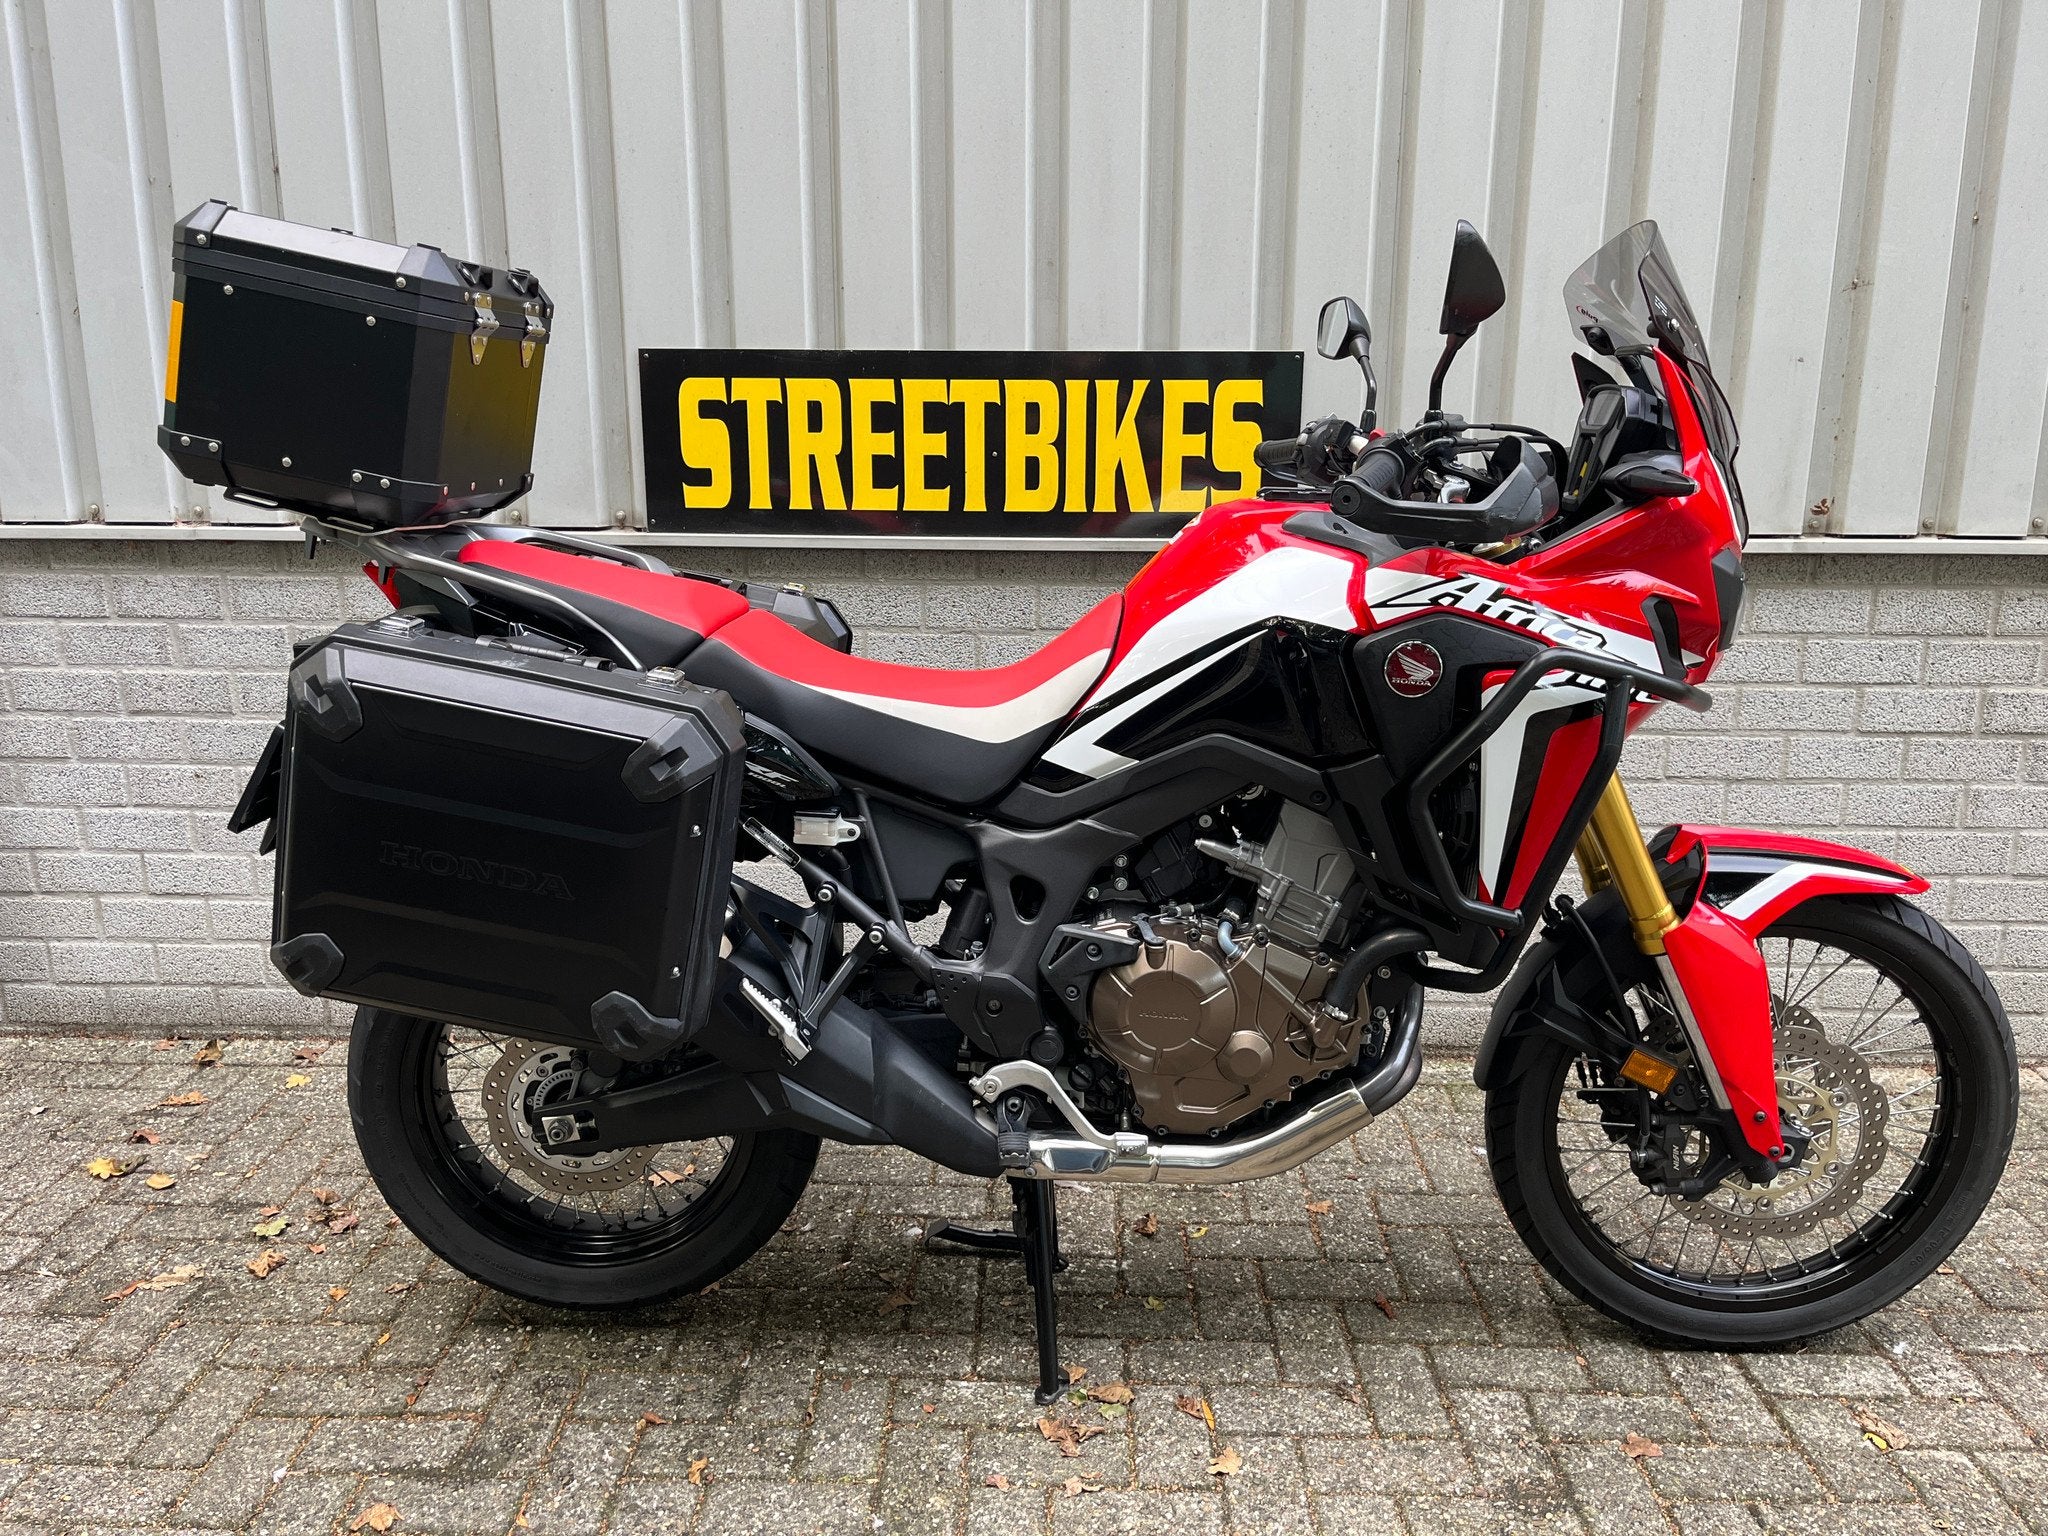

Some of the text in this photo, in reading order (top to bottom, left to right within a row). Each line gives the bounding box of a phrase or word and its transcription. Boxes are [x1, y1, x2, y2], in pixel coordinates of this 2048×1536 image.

[678, 377, 1264, 513] STREETBIKES
[1372, 573, 1608, 653] Africa
[1391, 677, 1432, 687] HONDA
[379, 840, 576, 901] HONDA
[1139, 1008, 1189, 1022] HONDA
